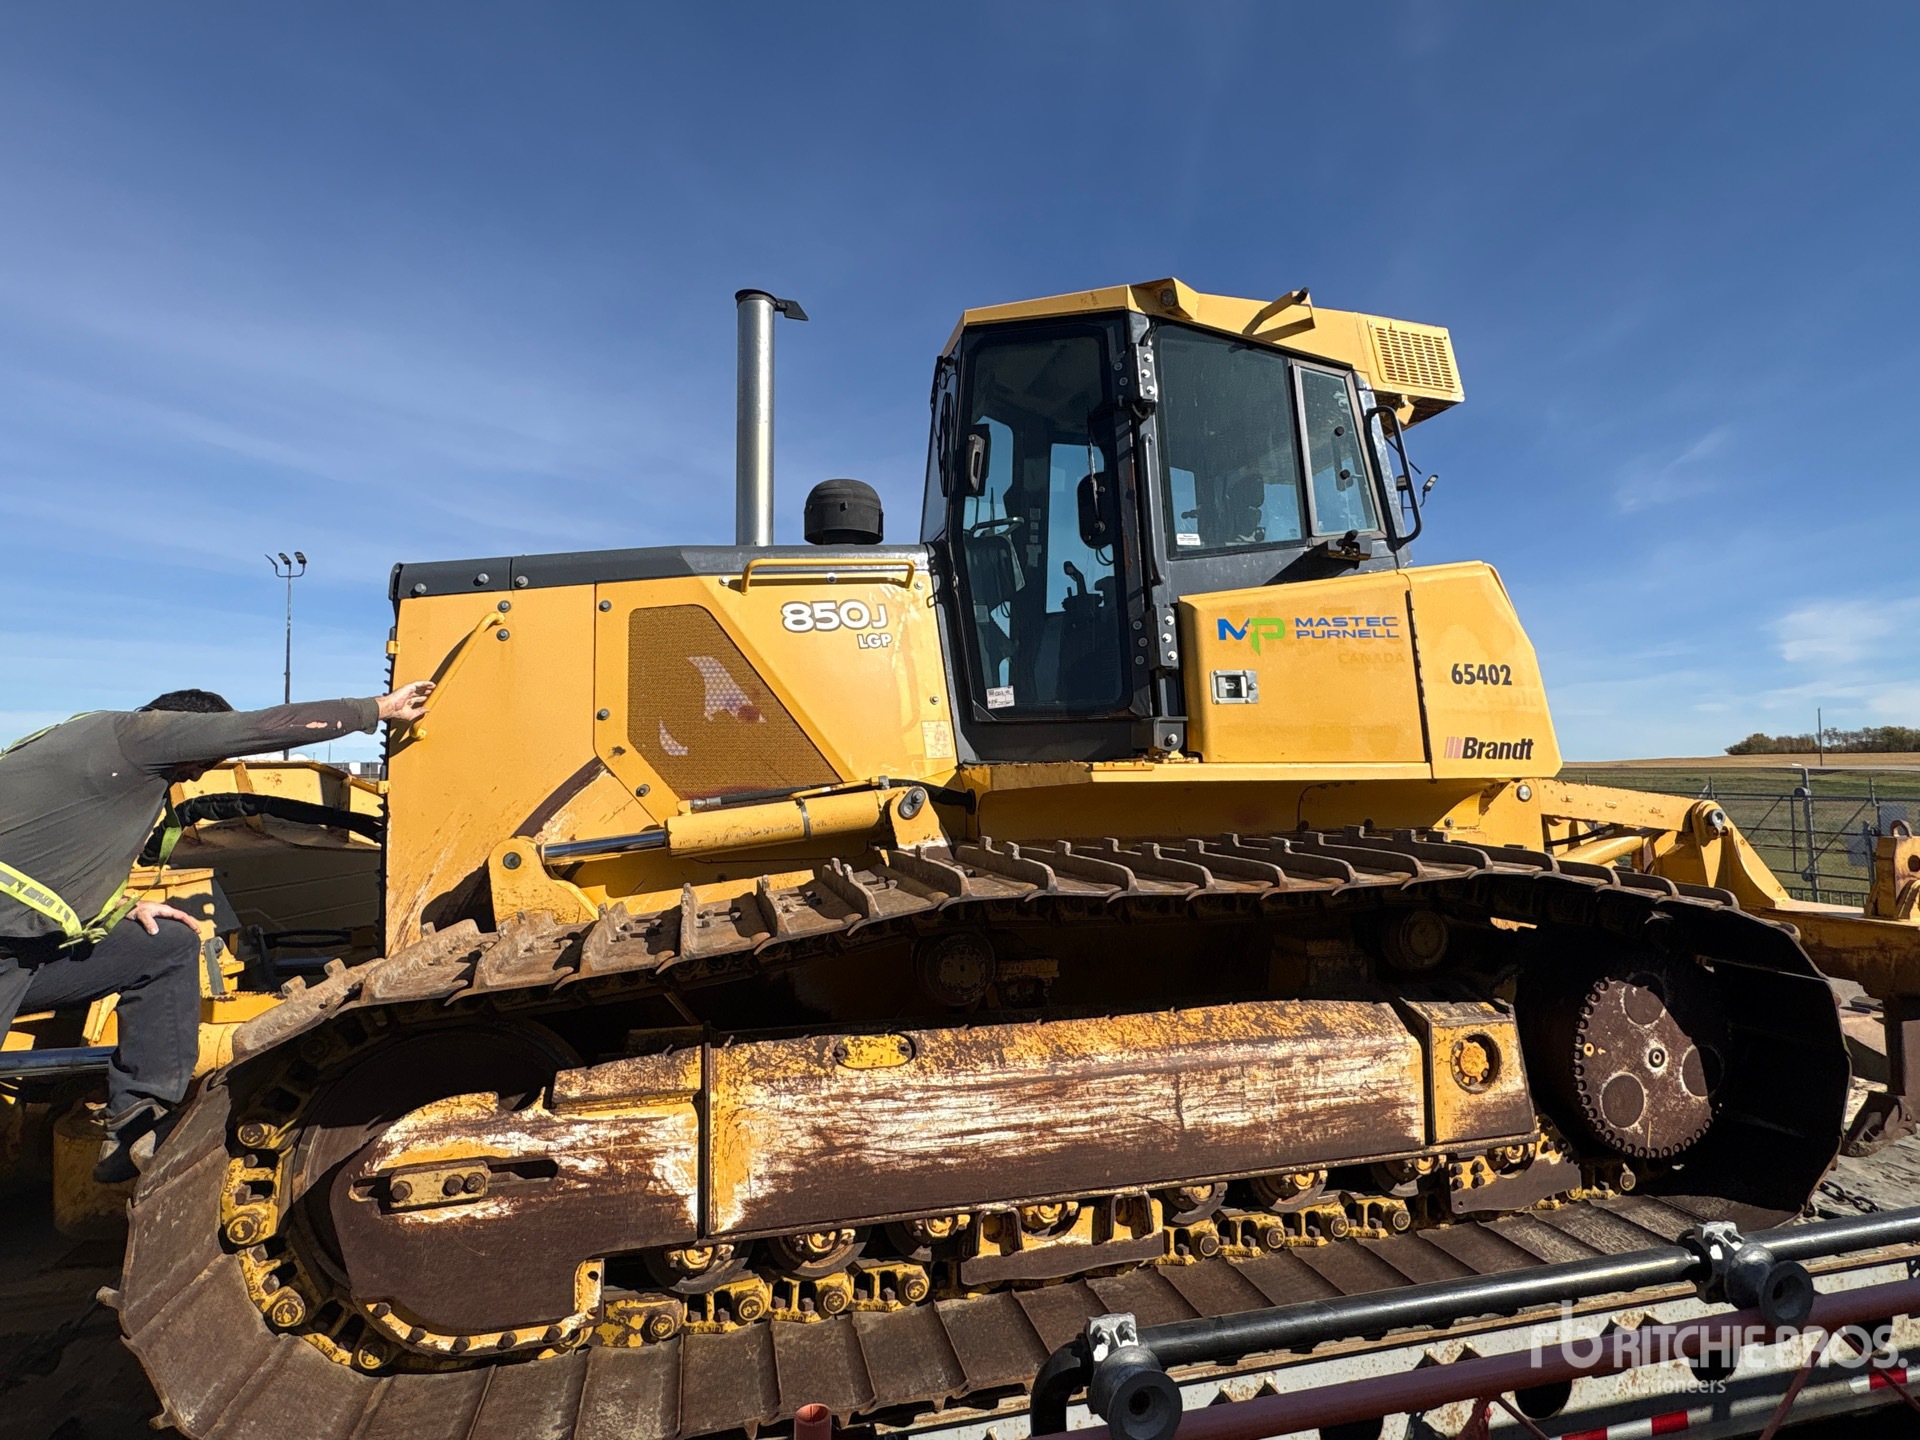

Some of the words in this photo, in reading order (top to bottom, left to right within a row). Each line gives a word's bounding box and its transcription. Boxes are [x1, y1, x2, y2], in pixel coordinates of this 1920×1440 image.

[781, 599, 888, 633] 850J
[1294, 616, 1399, 628] MASTEC
[857, 633, 892, 649] LGP
[1295, 628, 1400, 639] PURNELL
[1337, 651, 1406, 665] CANADA
[1450, 663, 1513, 687] 65402
[1462, 736, 1534, 761] Brandt
